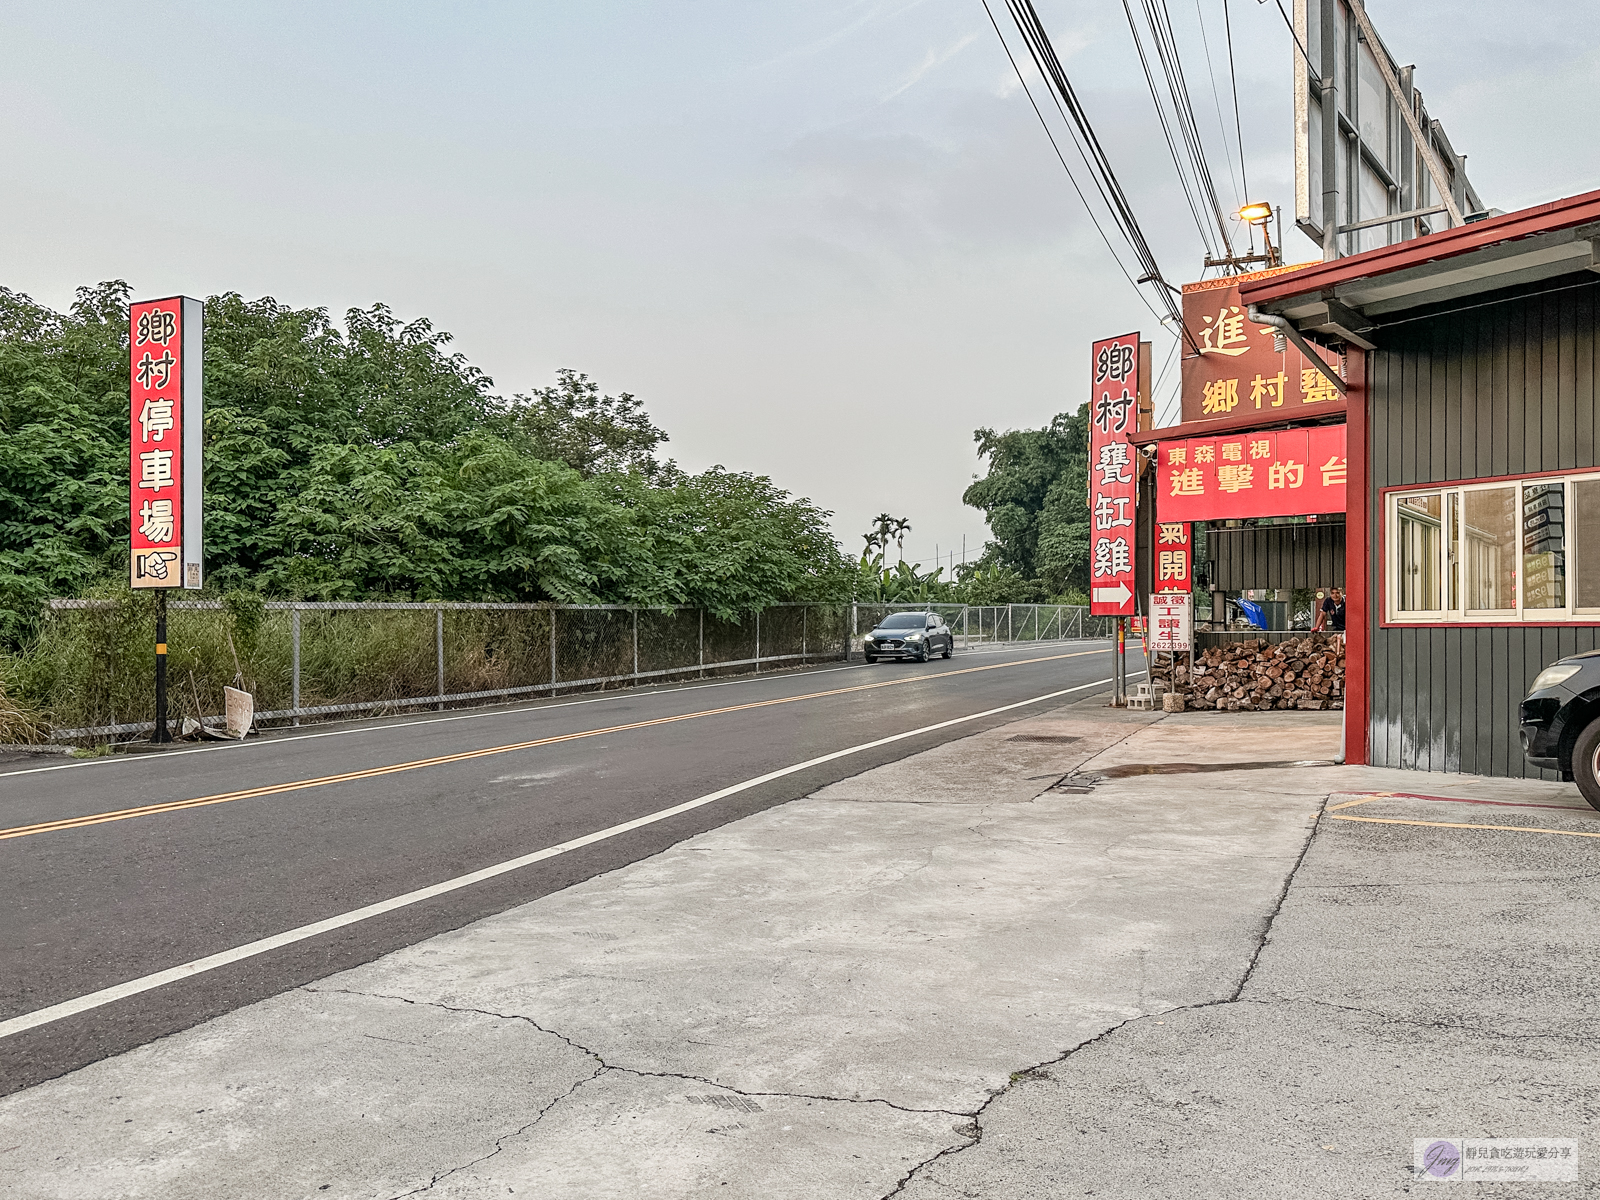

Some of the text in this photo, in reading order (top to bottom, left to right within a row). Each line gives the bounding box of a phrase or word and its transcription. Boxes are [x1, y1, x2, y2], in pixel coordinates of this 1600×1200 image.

[136, 308, 176, 544] 鄉村停車場
[1094, 341, 1133, 578] 鄉村甕缸雞
[1167, 439, 1271, 466] 東森電視
